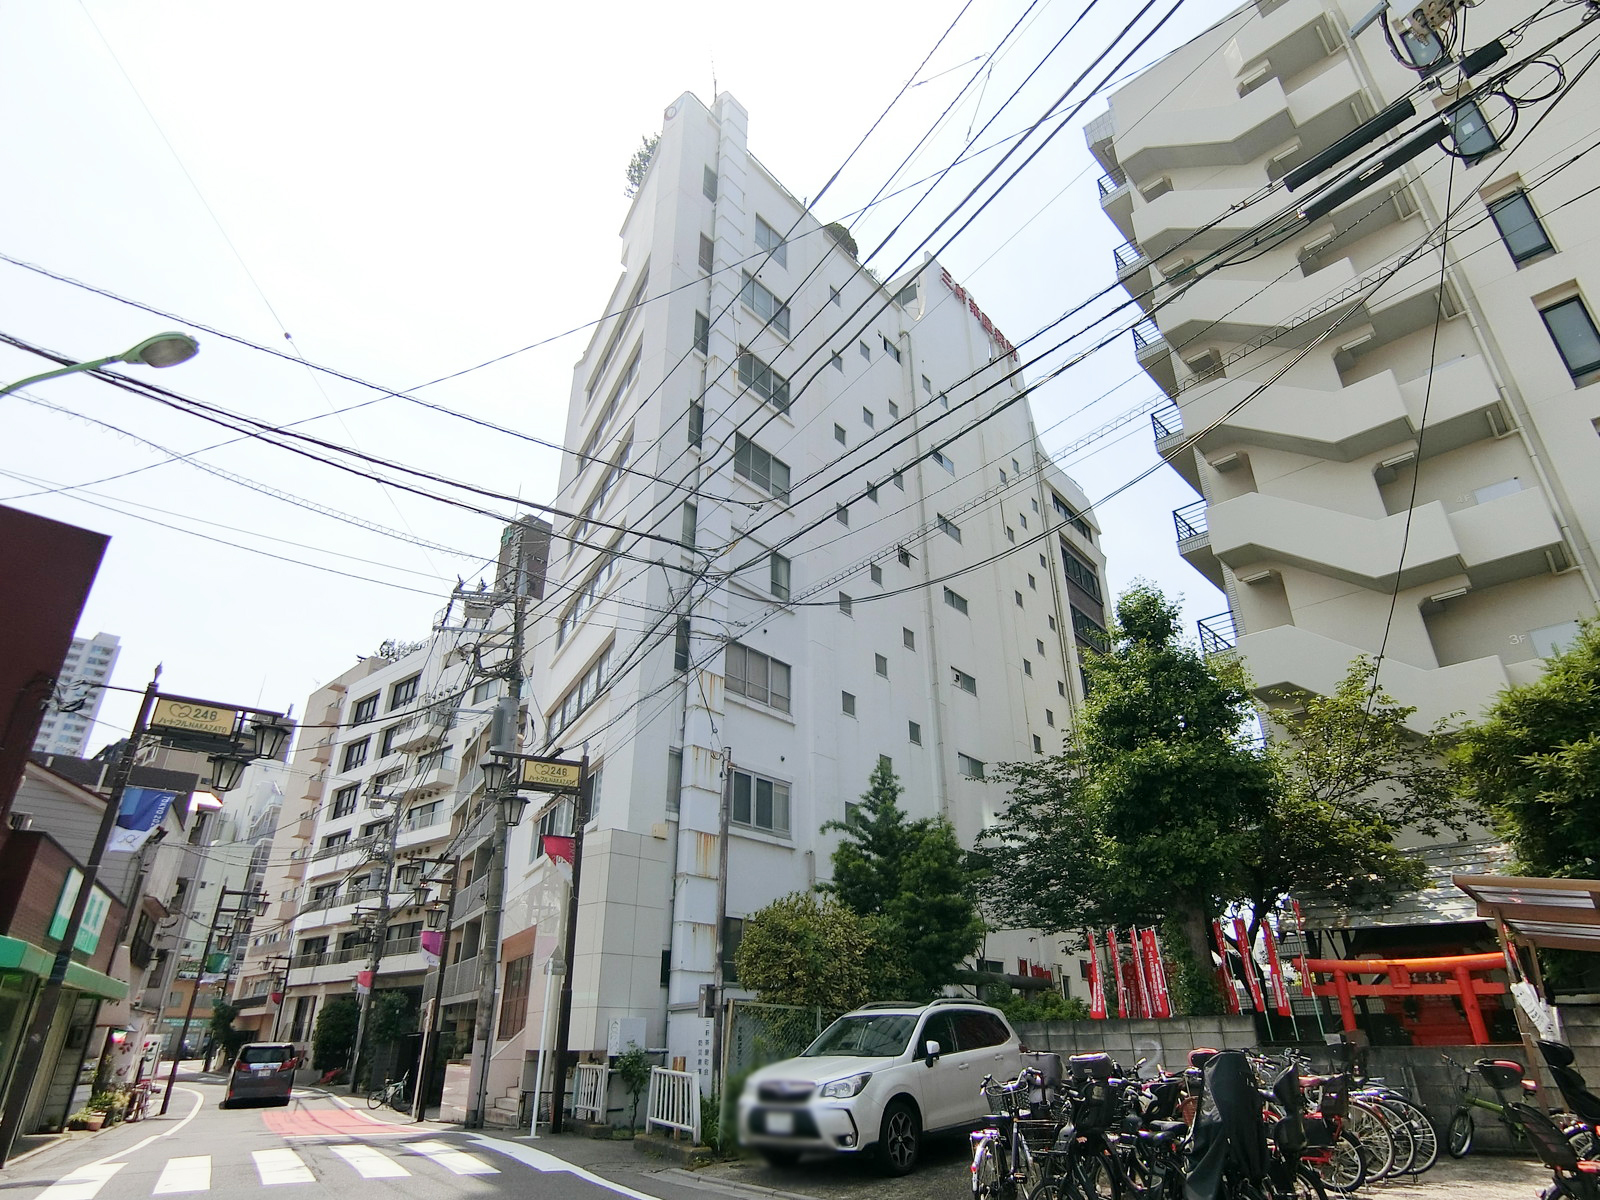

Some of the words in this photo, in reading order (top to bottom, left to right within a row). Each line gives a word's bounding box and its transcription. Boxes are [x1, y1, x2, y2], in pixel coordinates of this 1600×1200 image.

[1508, 634, 1526, 645] 3F
[550, 766, 568, 777] 246
[156, 796, 171, 815] TOKYO
